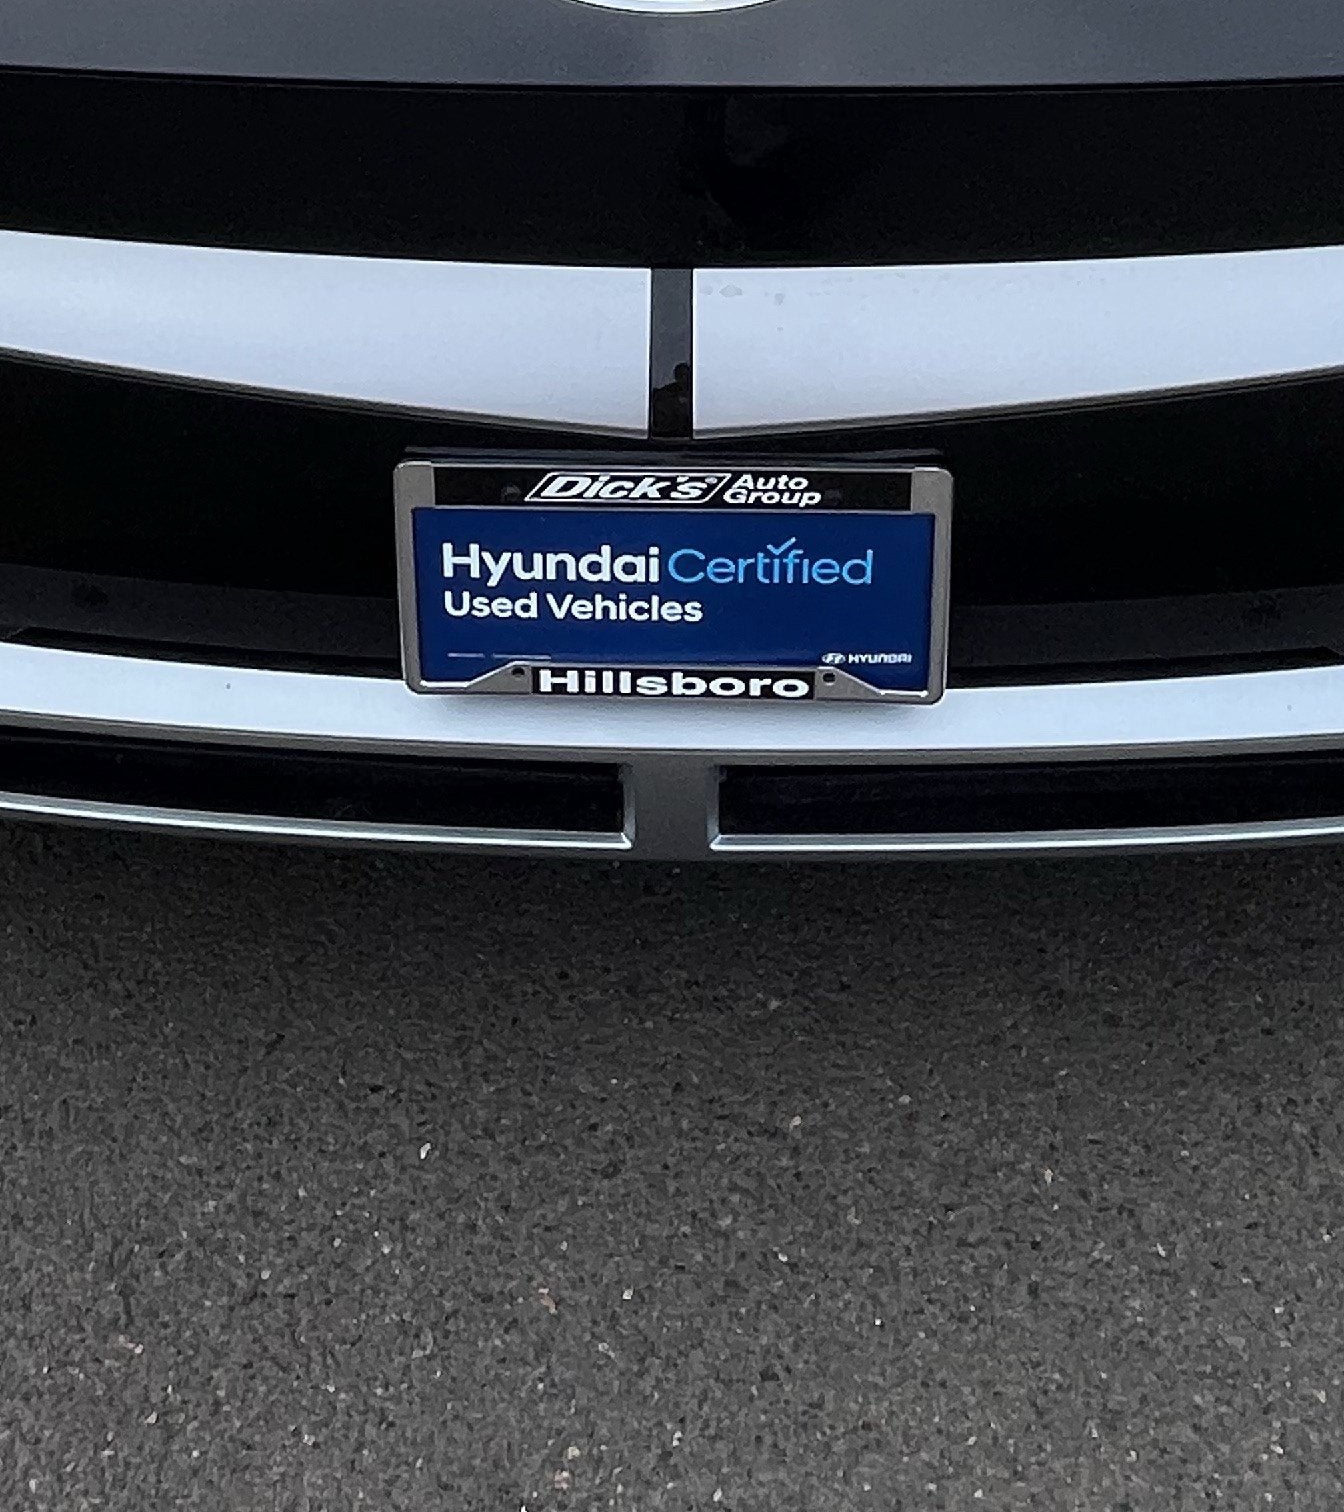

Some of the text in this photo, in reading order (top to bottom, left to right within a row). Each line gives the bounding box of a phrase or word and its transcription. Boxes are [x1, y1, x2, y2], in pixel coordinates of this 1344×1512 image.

[730, 474, 809, 491] Auto
[723, 488, 821, 508] Group
[441, 537, 873, 586] Hyundai Certified
[444, 593, 703, 623] Used Vehicles
[848, 653, 912, 664] HYUNDAI
[539, 670, 810, 698] Hillsboro
